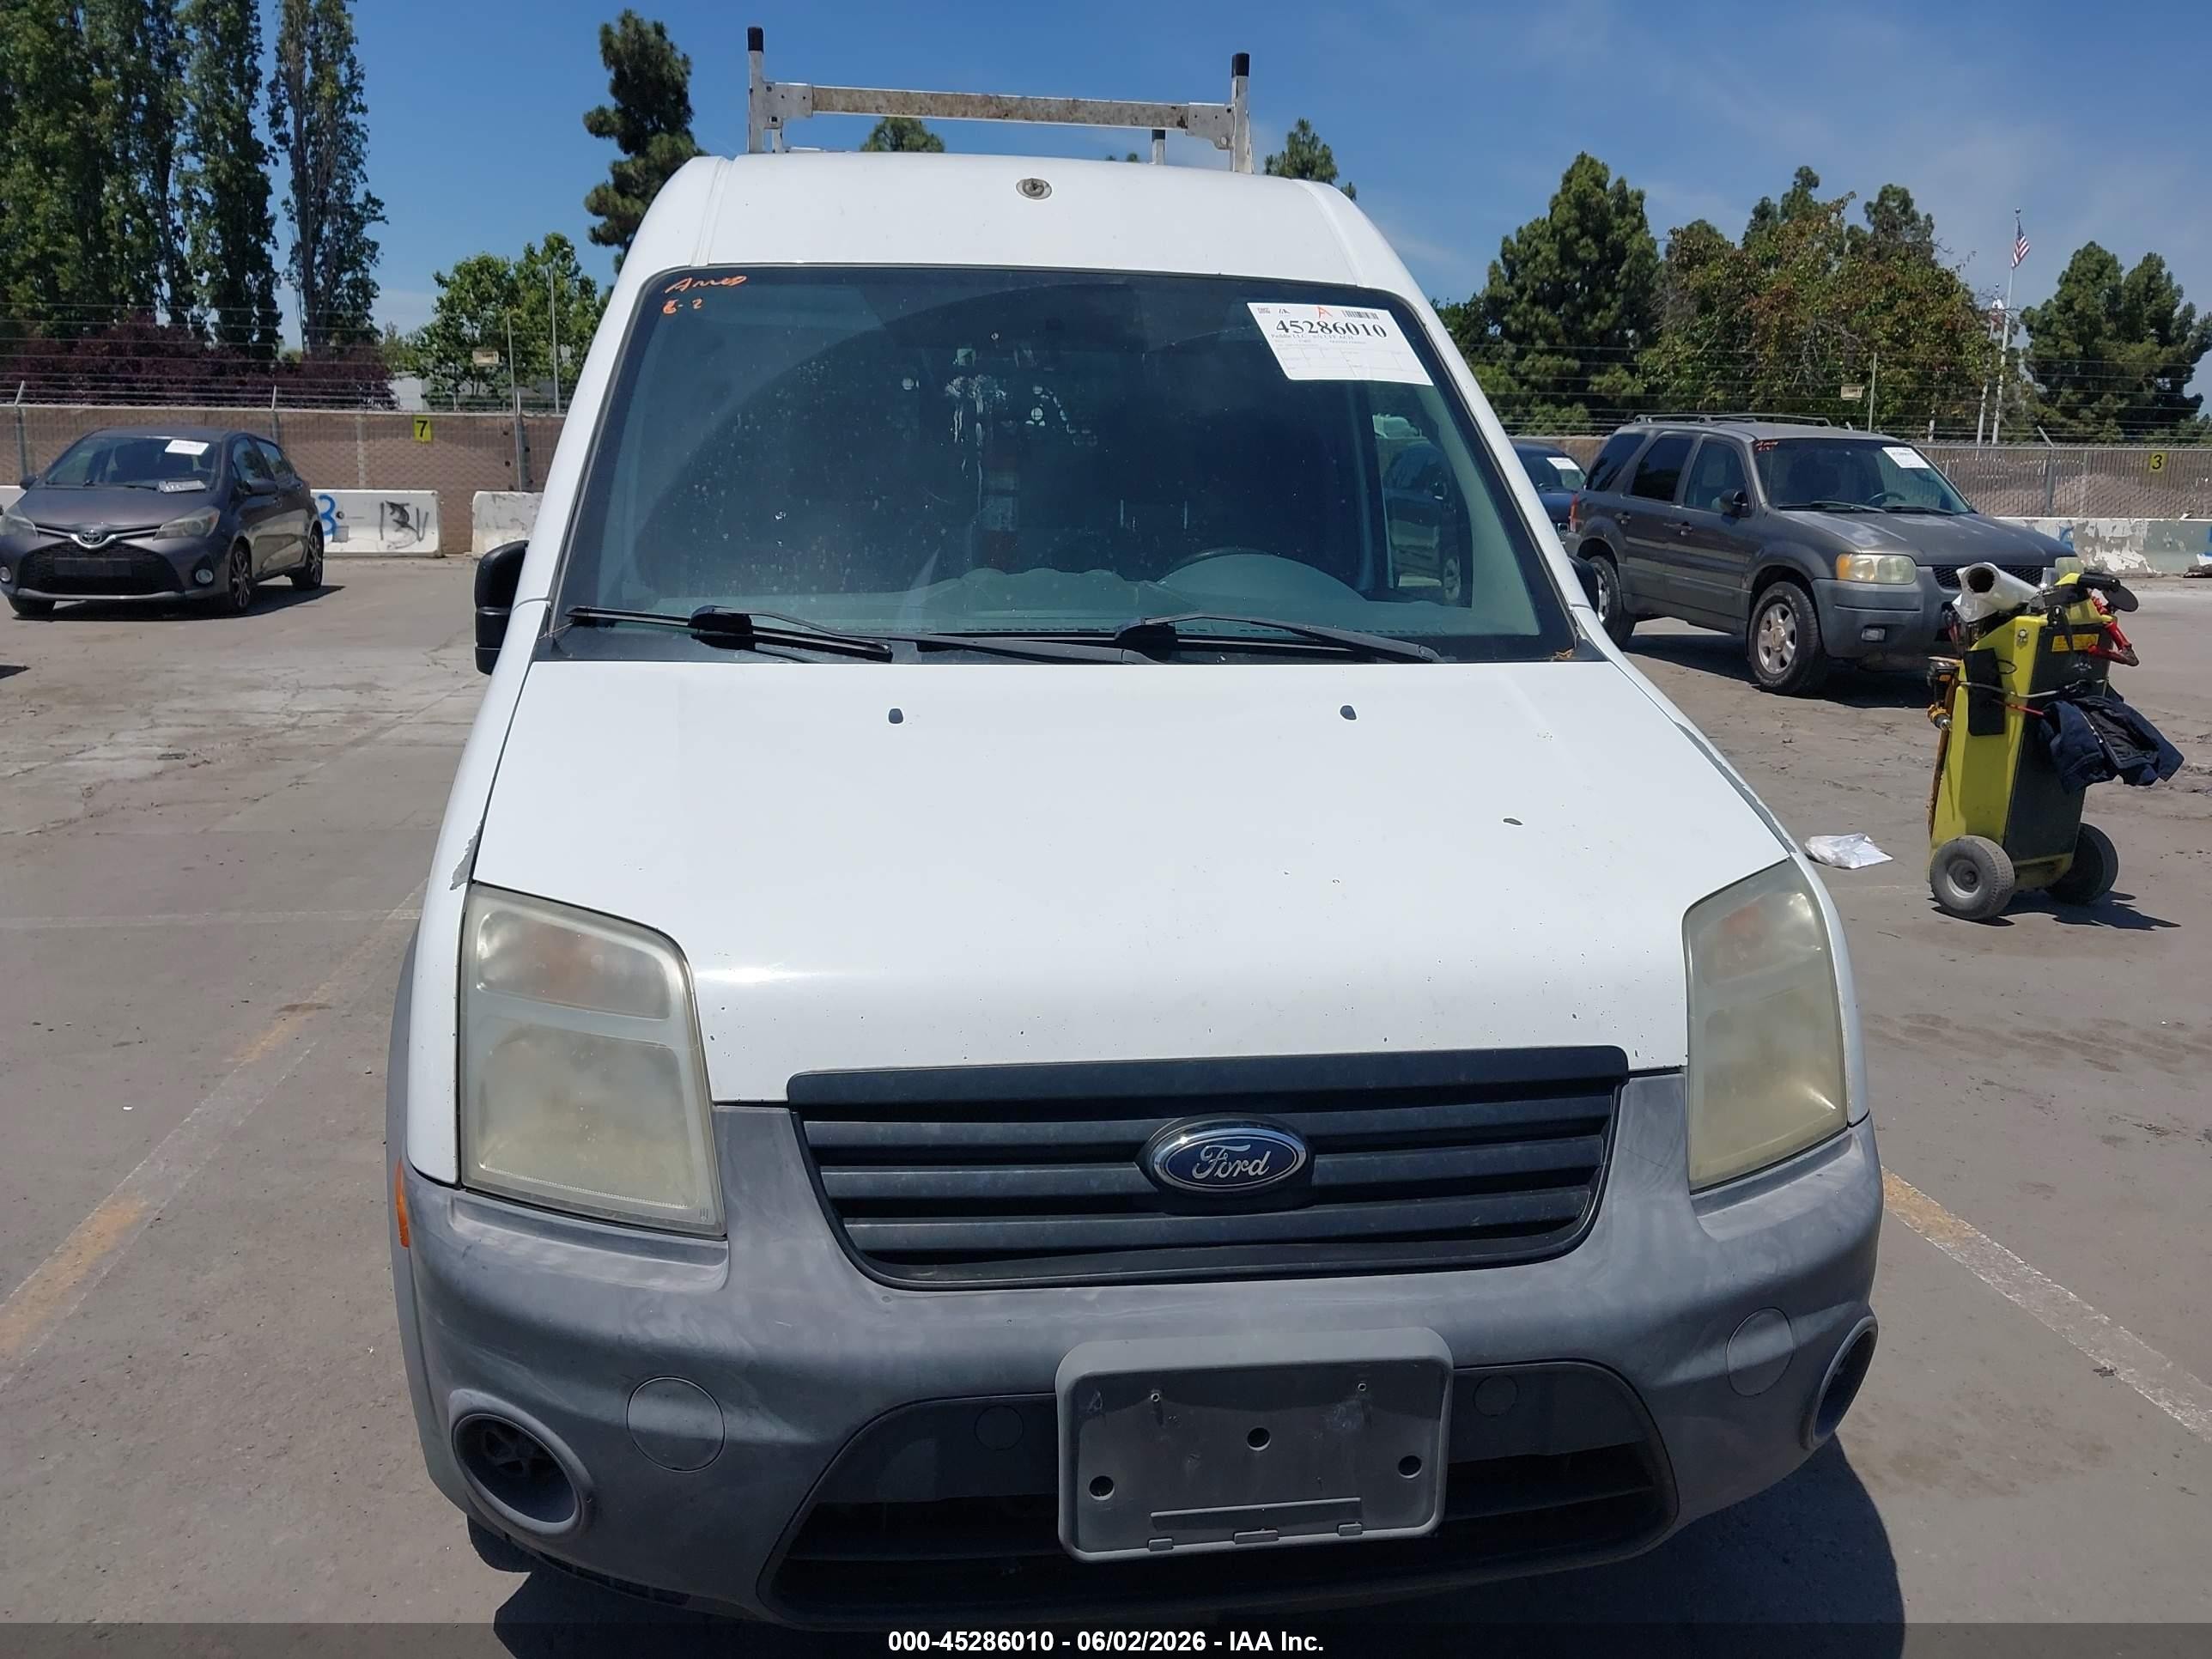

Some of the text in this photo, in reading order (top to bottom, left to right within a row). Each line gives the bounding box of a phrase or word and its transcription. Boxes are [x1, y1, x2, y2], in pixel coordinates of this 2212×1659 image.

[1275, 319, 1388, 338] 45286010
[416, 420, 428, 437] 7
[2152, 454, 2162, 470] 3
[1192, 1144, 1272, 1180] Ford
